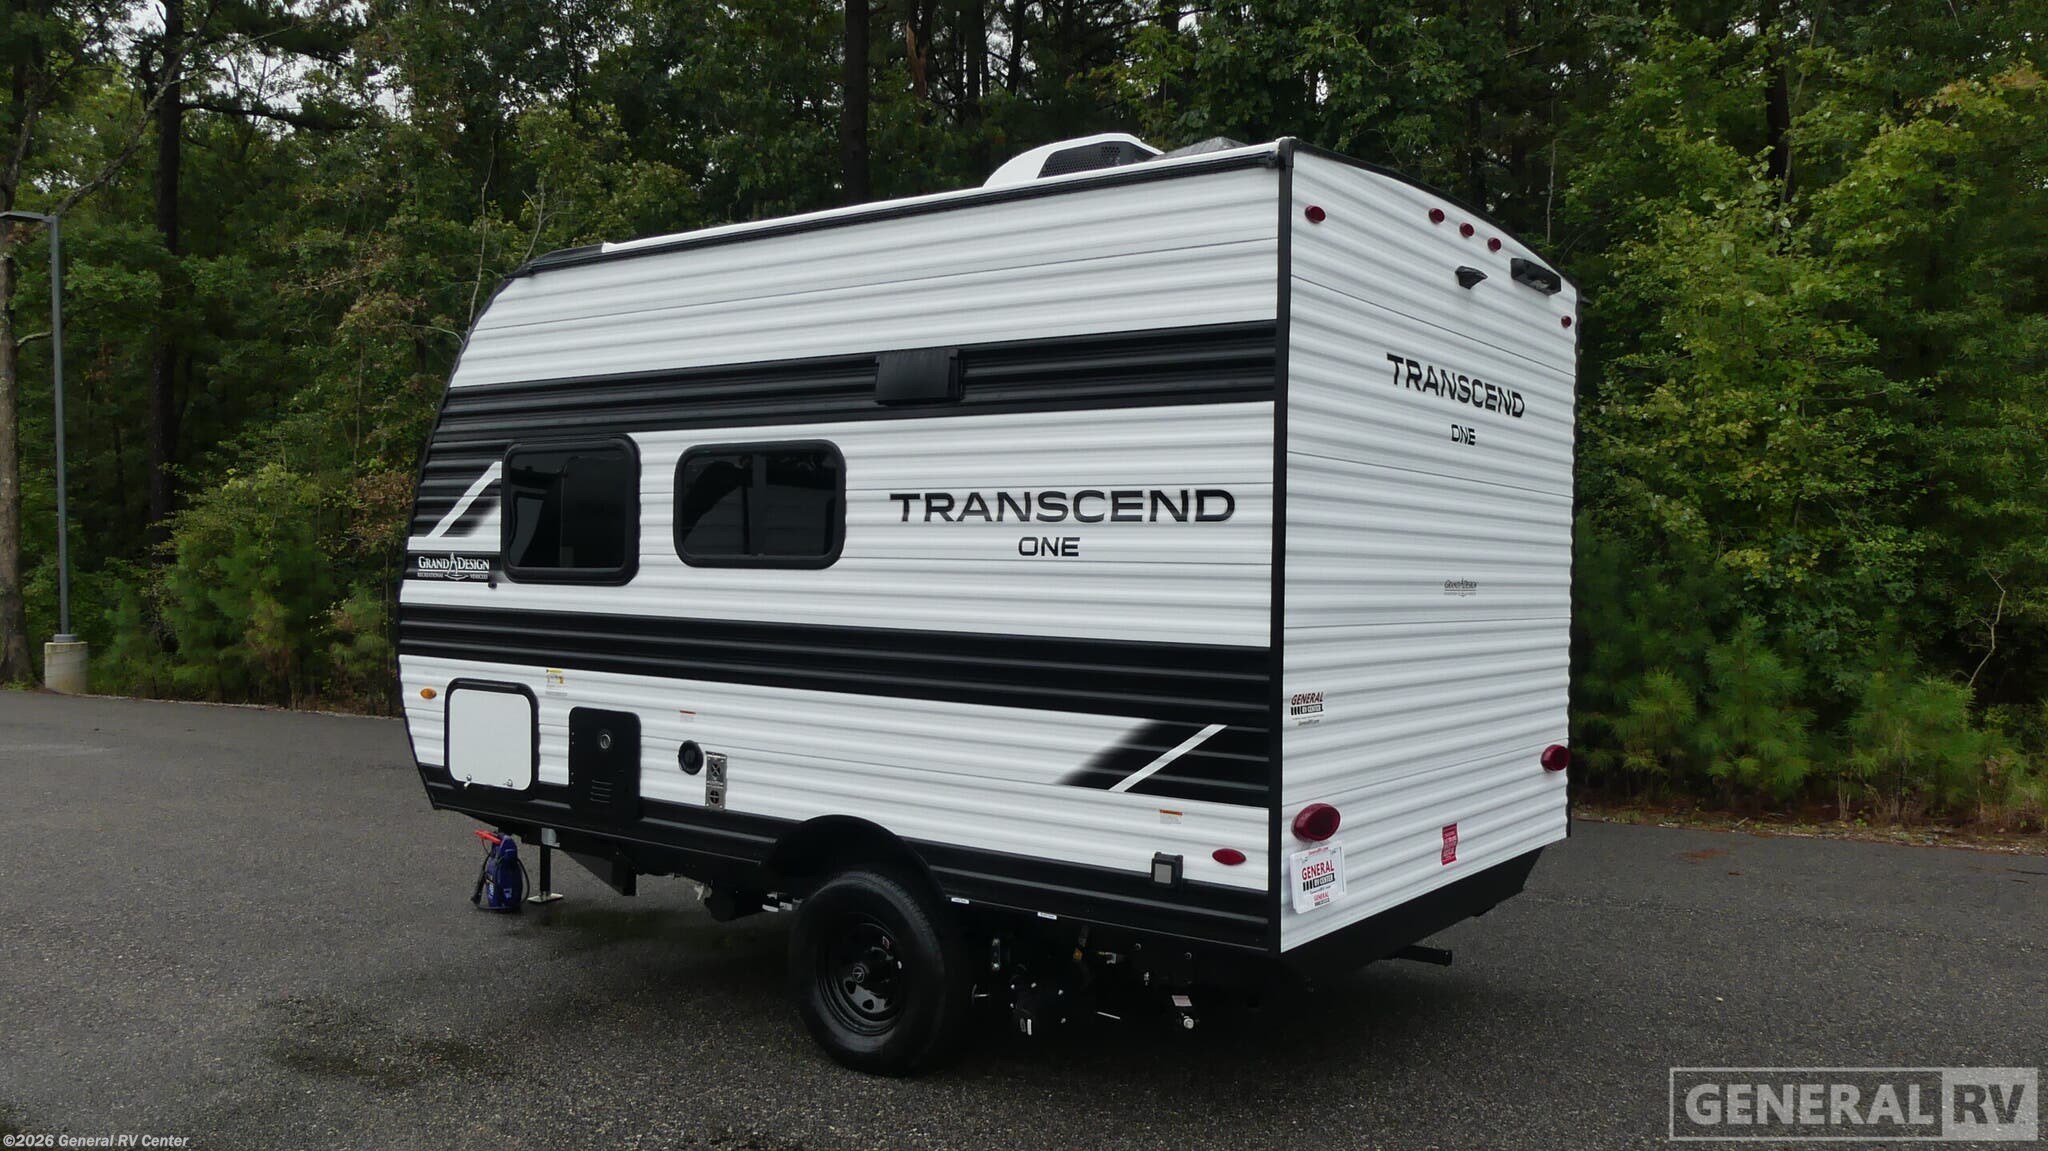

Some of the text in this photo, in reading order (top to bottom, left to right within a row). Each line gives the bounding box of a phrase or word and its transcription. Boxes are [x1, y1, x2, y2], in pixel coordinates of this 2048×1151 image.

[1387, 352, 1525, 418] TRANSCEND
[1451, 424, 1476, 445] ONE
[890, 489, 1235, 523] TRANSCEND
[1018, 536, 1080, 556] ONE
[418, 556, 490, 570] GRAND DESIGN
[1291, 691, 1324, 705] GENERAL
[1302, 860, 1335, 880] GENERAL
[1320, 874, 1333, 886] CENTER
